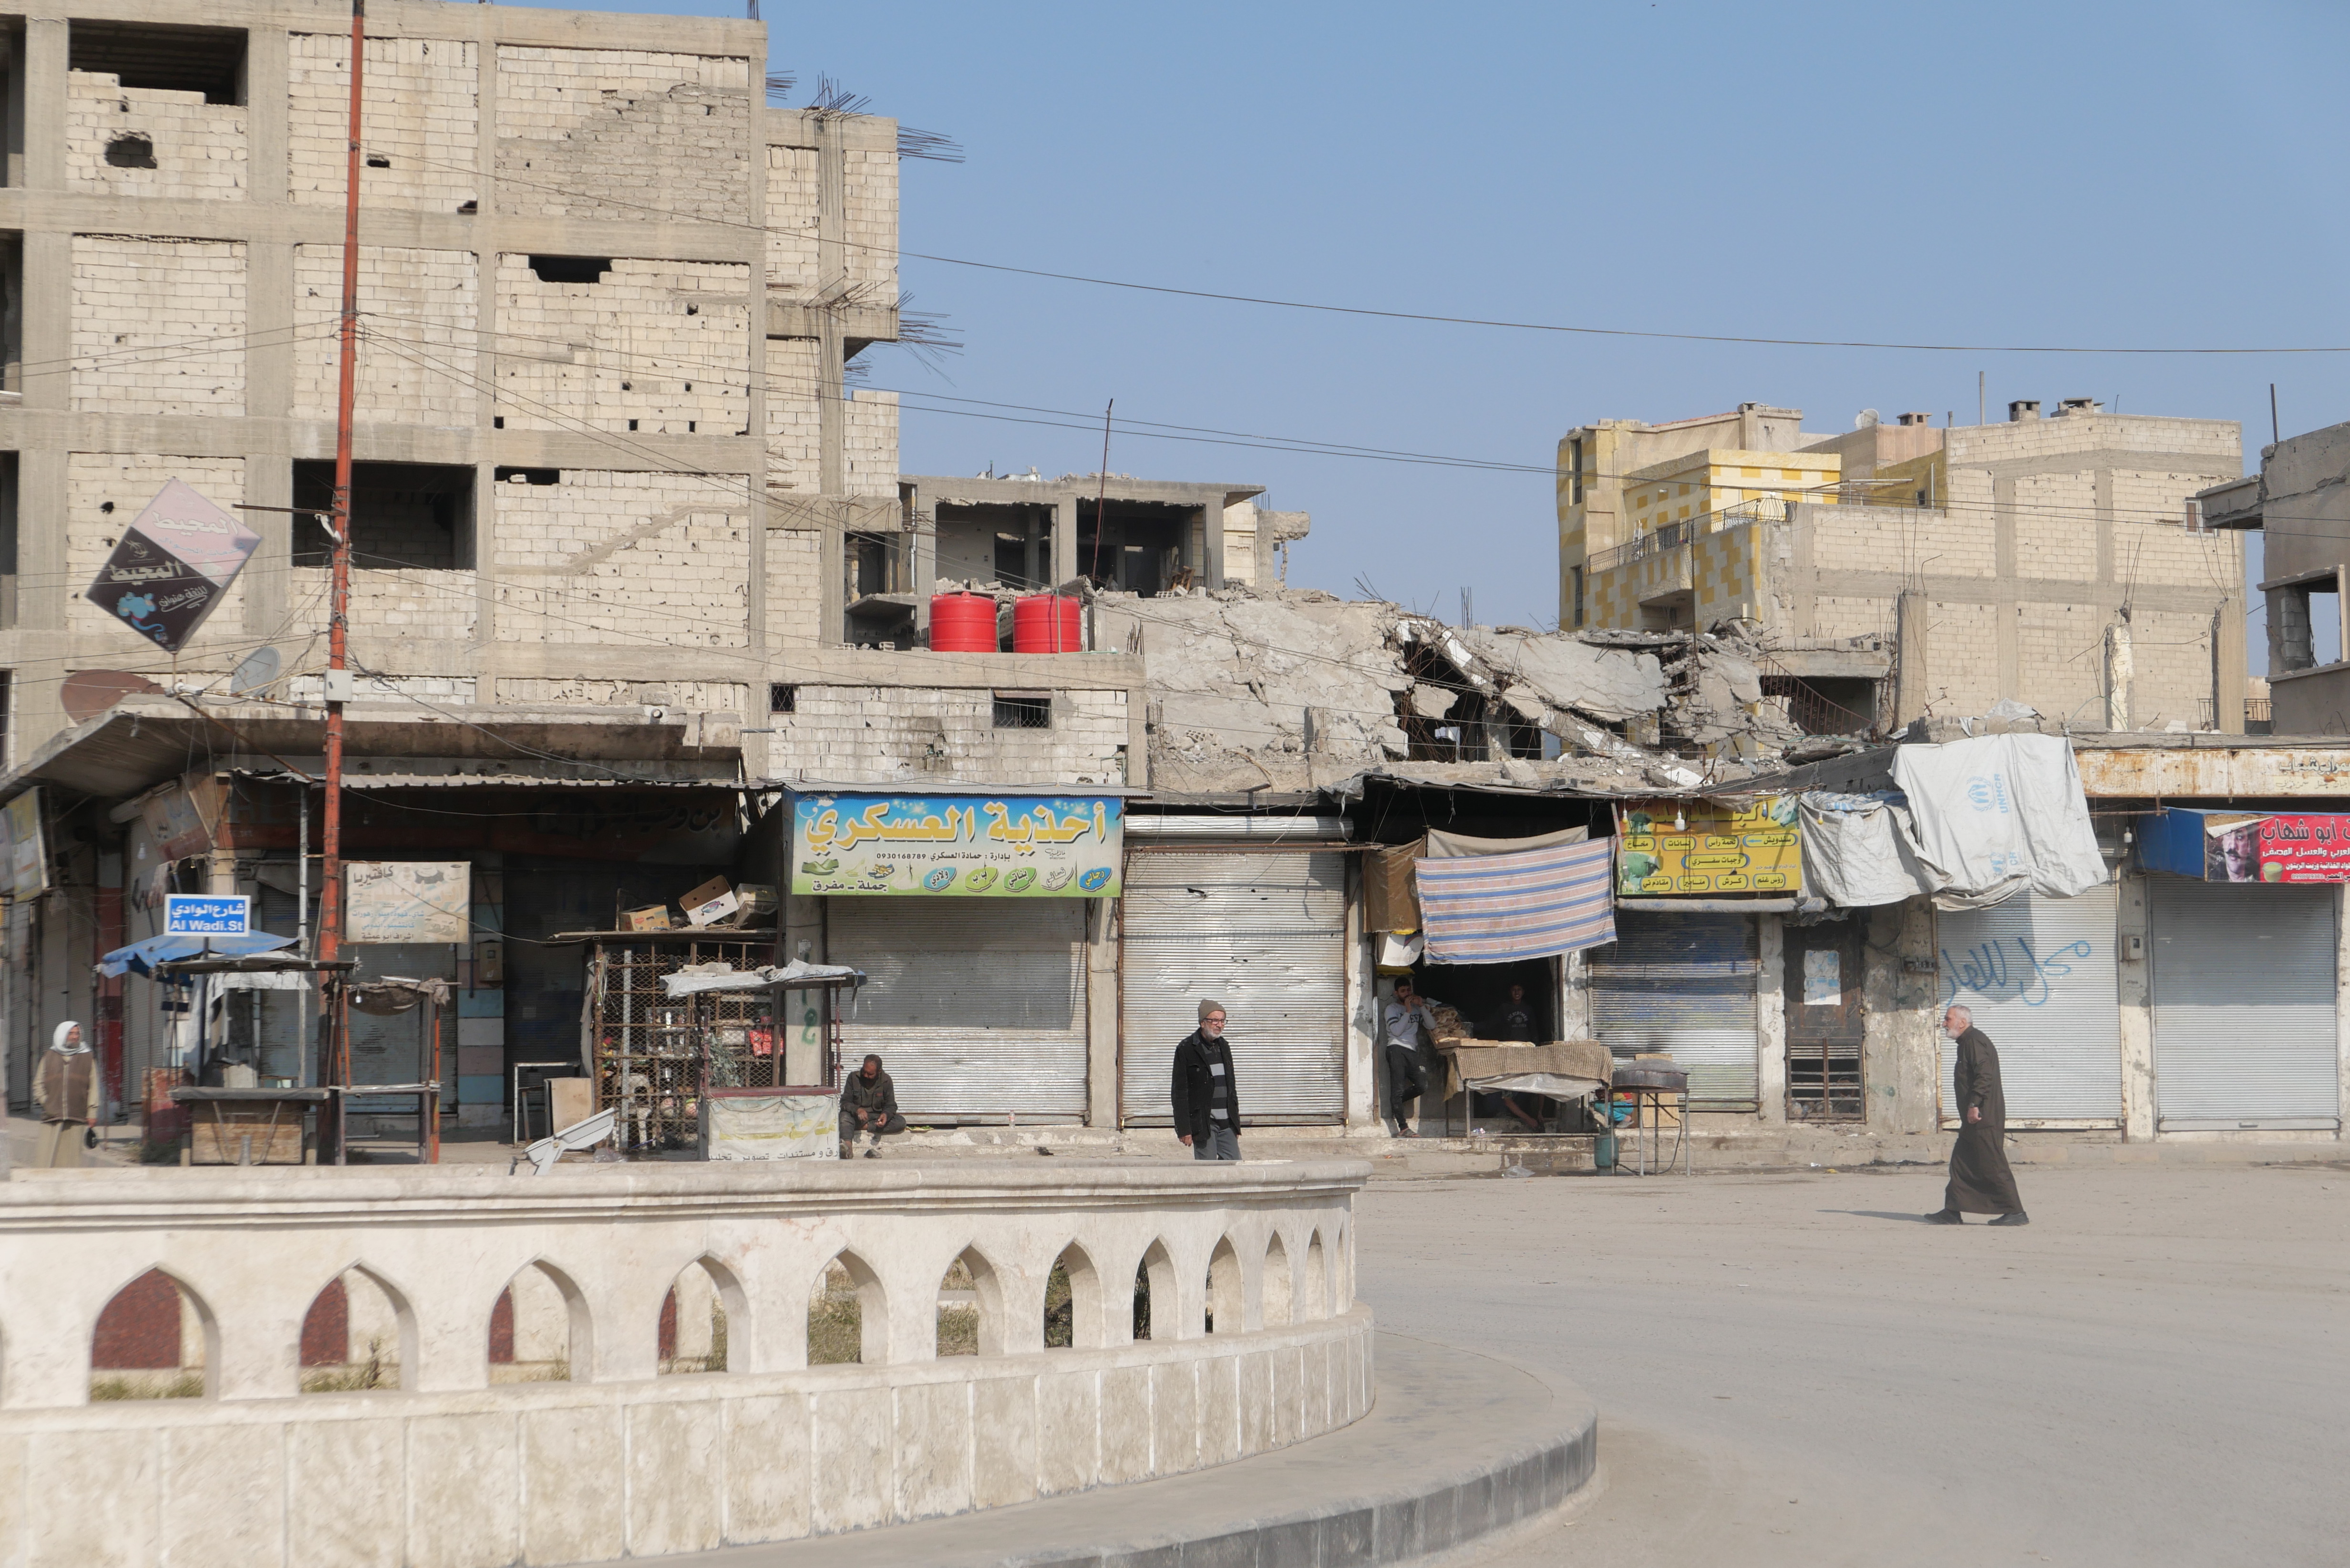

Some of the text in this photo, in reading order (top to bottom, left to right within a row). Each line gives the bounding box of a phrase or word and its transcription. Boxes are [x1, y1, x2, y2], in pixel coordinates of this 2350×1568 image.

[152, 510, 238, 536] المحيط
[109, 560, 183, 586] المحيط
[1994, 774, 2009, 814] UNHCR
[805, 801, 1105, 856] أحذية العسكري
[2261, 818, 2309, 845] شهاب
[2316, 818, 2337, 845] أبو
[930, 852, 960, 861] العسكري
[2296, 847, 2327, 857] والعسل
[1009, 868, 1028, 887] بناتي
[1085, 869, 1105, 887] رجالي
[172, 903, 245, 918] شارع الوادي
[170, 920, 186, 931] Al
